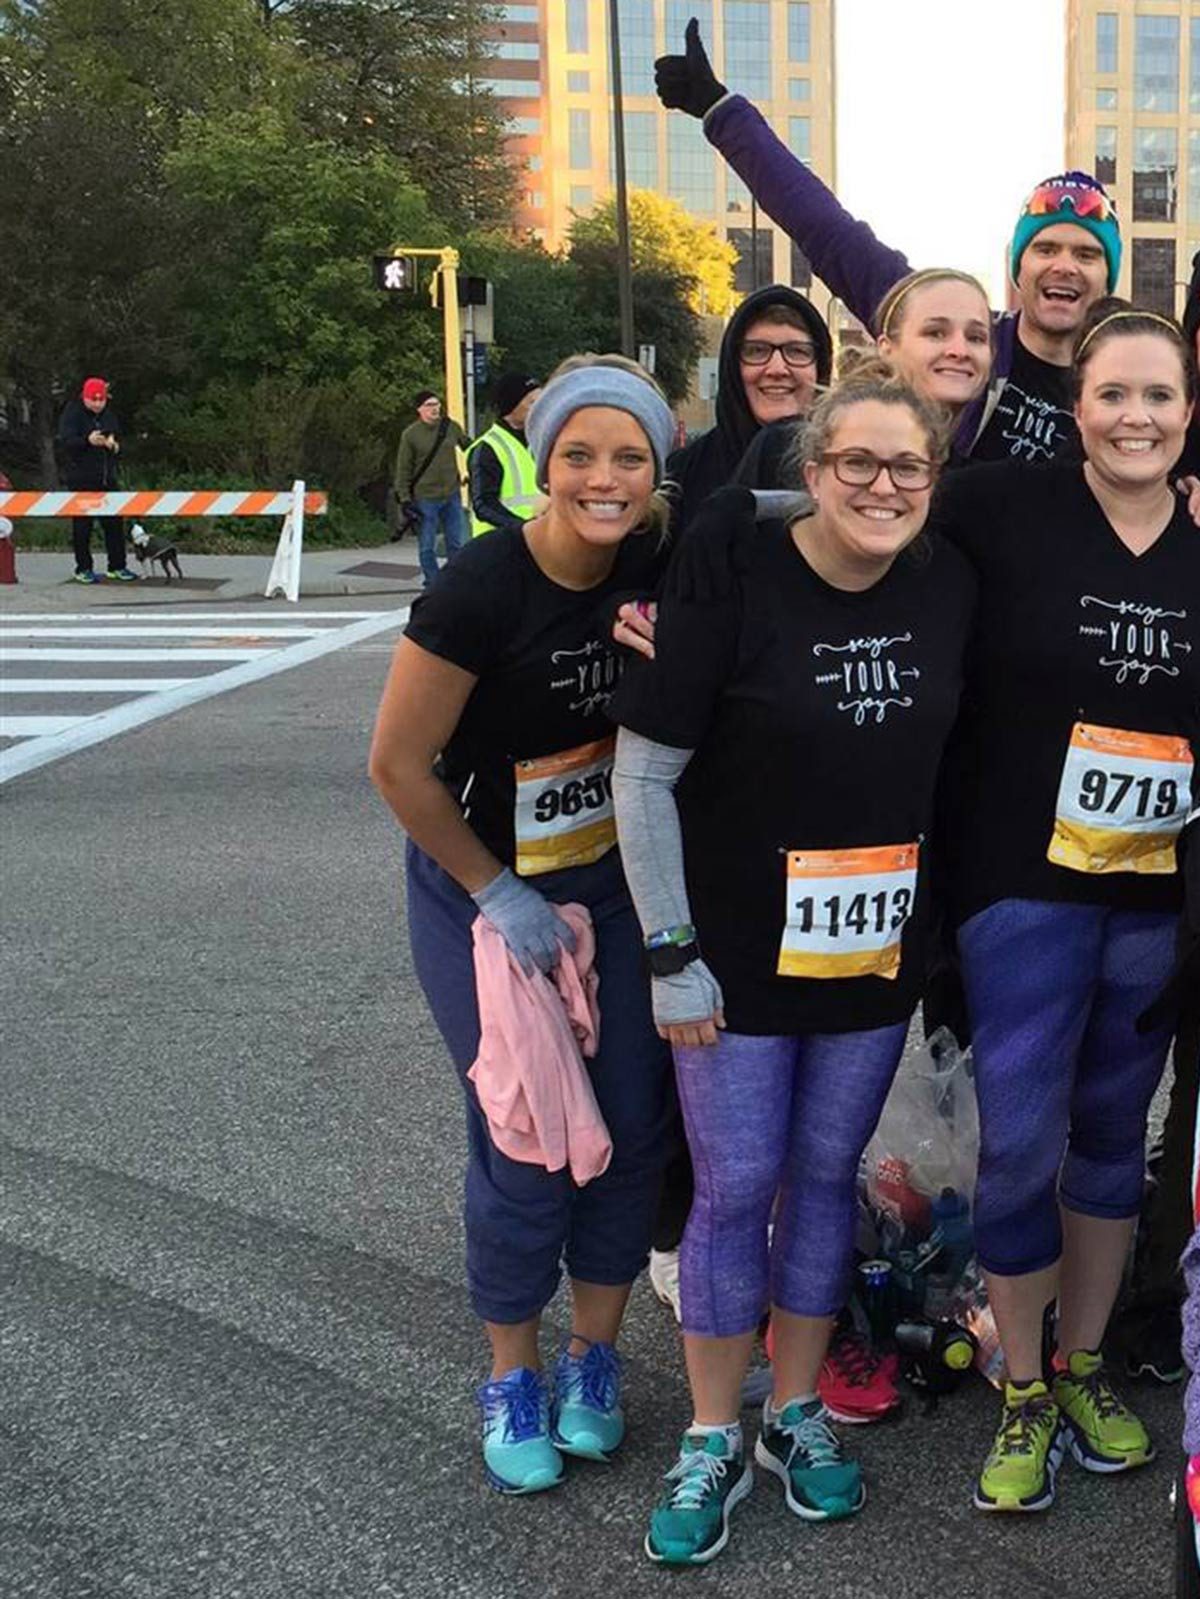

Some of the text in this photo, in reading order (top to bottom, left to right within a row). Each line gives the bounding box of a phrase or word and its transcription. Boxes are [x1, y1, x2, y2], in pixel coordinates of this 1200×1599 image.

[1014, 404, 1056, 446] YOUR
[1081, 595, 1186, 625] seize
[813, 631, 912, 658] seize
[1110, 621, 1170, 659] YOUR
[843, 660, 900, 693] YOUR
[1099, 656, 1180, 684] joy
[837, 696, 913, 726] joy
[1078, 768, 1179, 817] 9719
[795, 887, 912, 938] 11413
